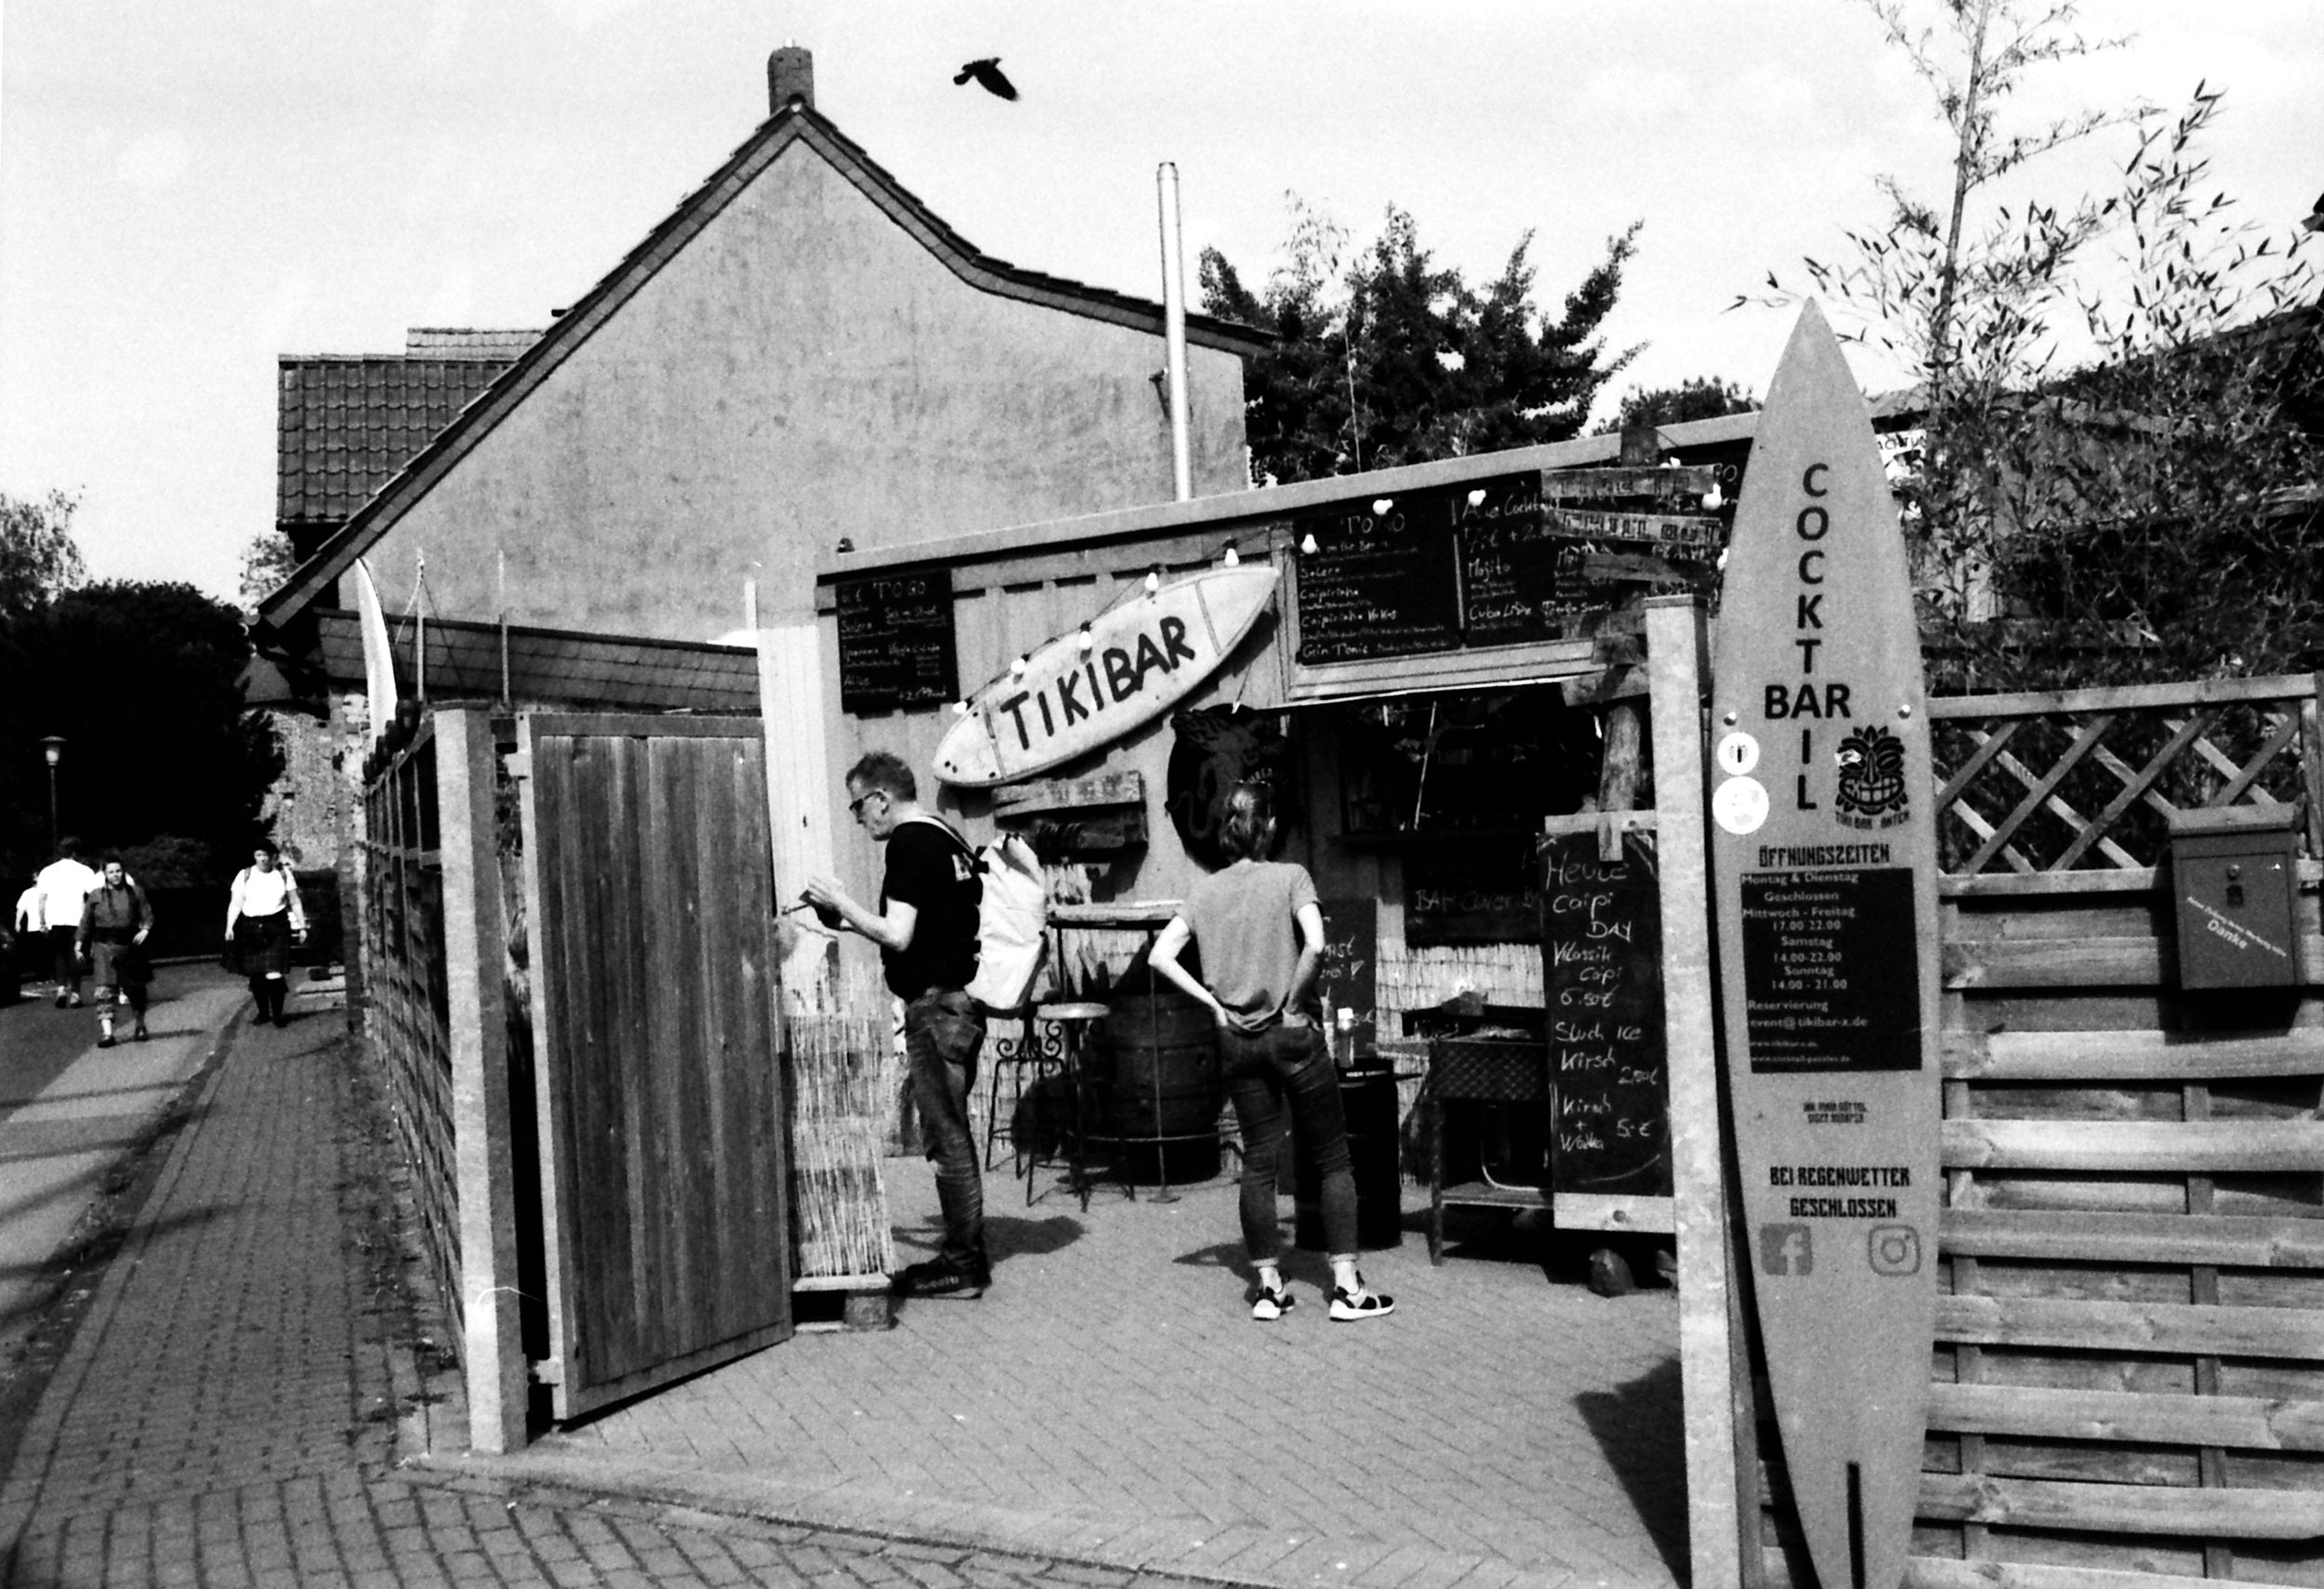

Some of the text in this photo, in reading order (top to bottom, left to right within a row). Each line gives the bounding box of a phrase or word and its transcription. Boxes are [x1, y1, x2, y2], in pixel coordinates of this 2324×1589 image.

[1468, 557, 1512, 583] Mojito
[1299, 586, 1360, 604] Caipirinha
[1301, 643, 1330, 658] Gin
[1330, 642, 1369, 657] Tonic
[999, 616, 1196, 750] TIKIBAR
[1764, 682, 1852, 721] BAR
[1759, 844, 1891, 867] ÖFFNUNGSZEITEN
[1742, 872, 1859, 886] Montag & Dienstag
[1552, 891, 1615, 920] Caipi
[1763, 891, 1840, 902] Geschlossen
[1743, 907, 1800, 919] Mittwoch
[1811, 906, 1856, 919] Freitag
[1780, 935, 1834, 949] Samstag
[1579, 966, 1623, 987] Caipi
[1784, 965, 1835, 978] Sonntag
[1748, 999, 1829, 1013] Reservierung
[1560, 1044, 1617, 1071] Kirsch
[1564, 1092, 1613, 1117] Kirsch
[1769, 1166, 1910, 1187] BEI REGENWETTER
[1789, 1197, 1897, 1219] GESCHLOSSEN
